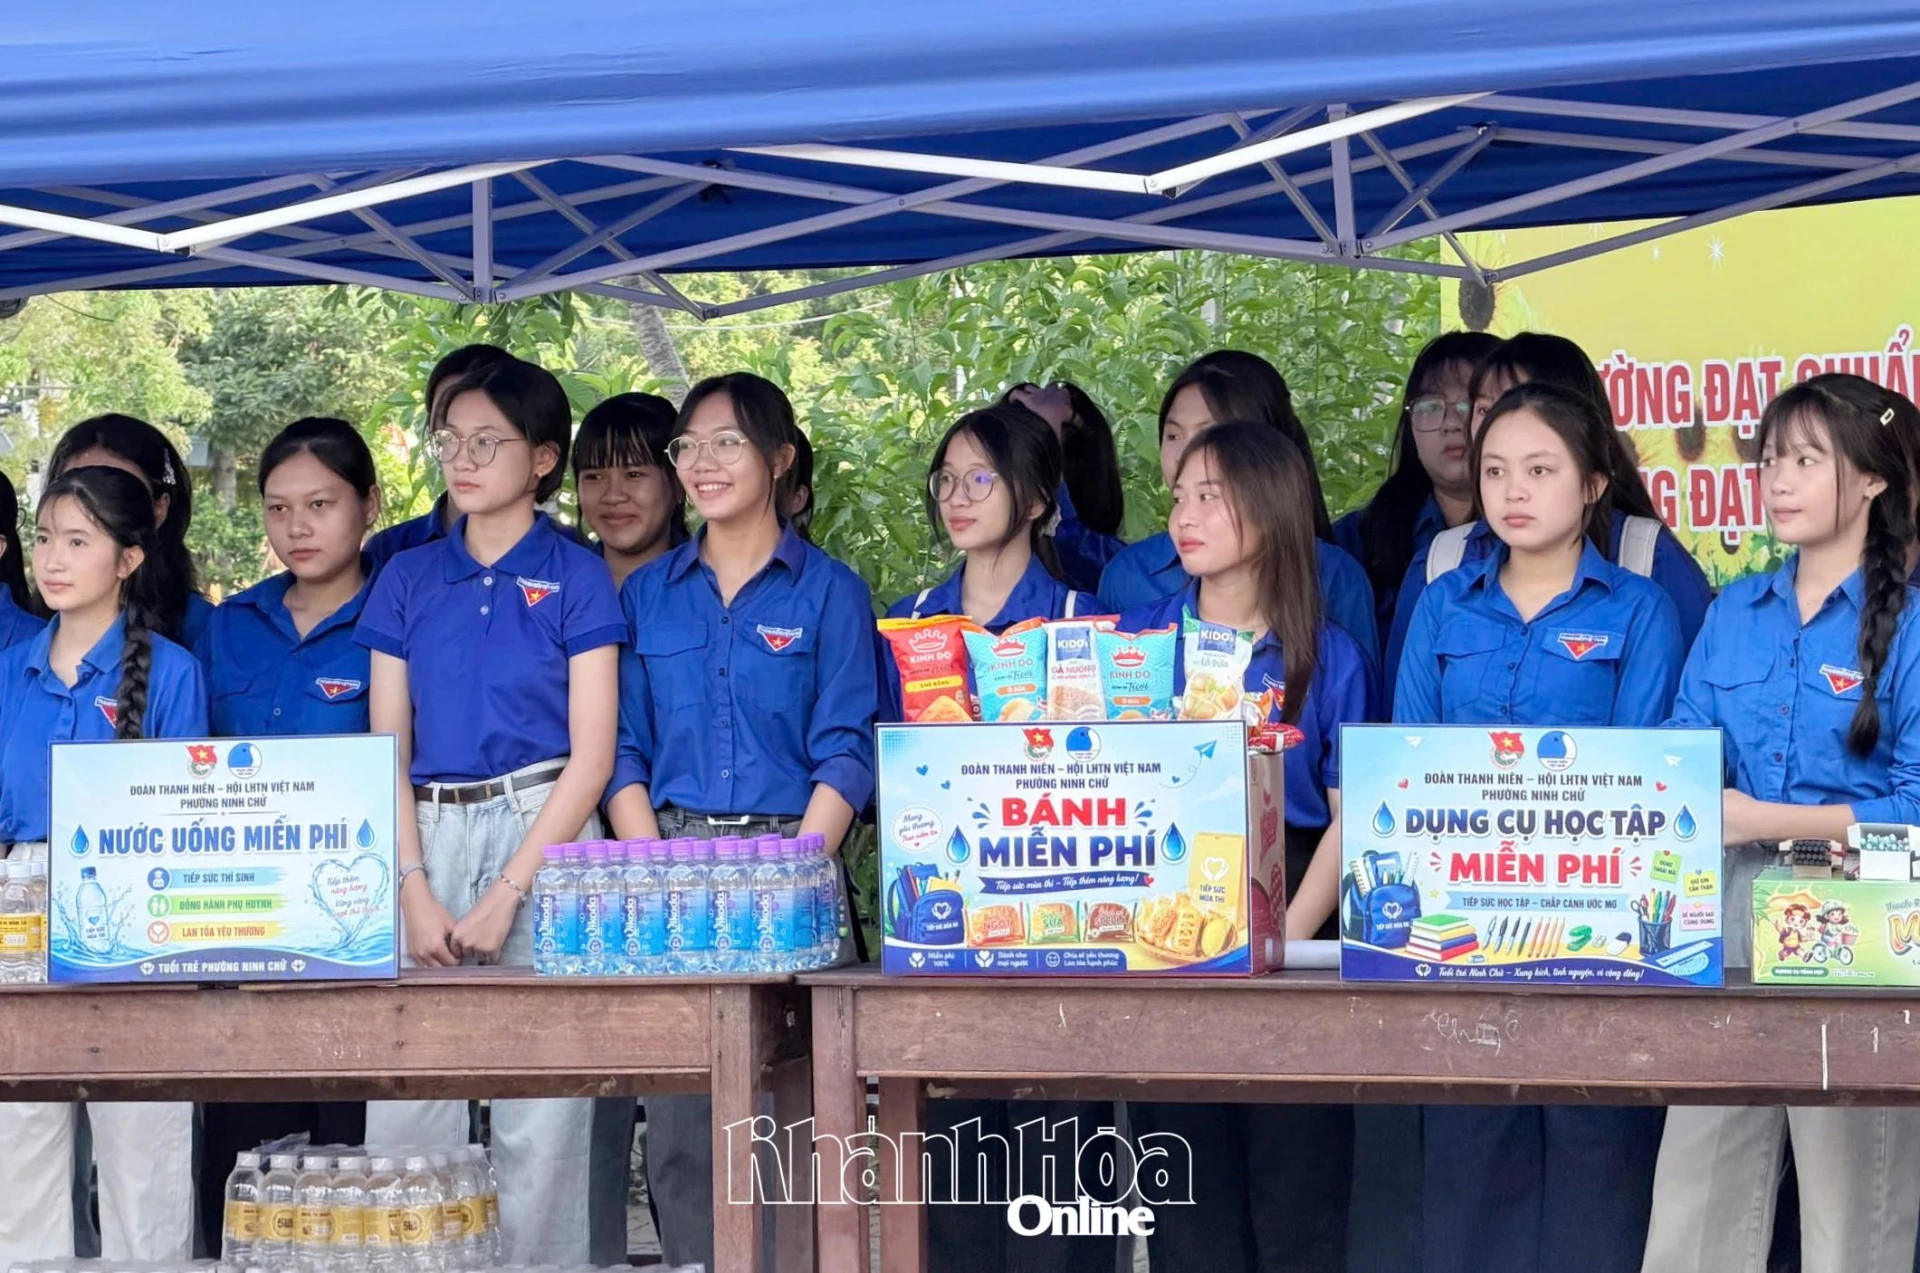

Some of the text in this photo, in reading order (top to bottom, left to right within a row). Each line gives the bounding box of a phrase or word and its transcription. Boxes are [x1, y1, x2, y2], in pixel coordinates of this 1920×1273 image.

[1704, 361, 1782, 434] ĐẠT
[1691, 468, 1767, 540] ĐẠT
[910, 651, 935, 664] KINH
[990, 660, 1017, 671] KINH
[1110, 671, 1133, 679] KINH
[961, 761, 1161, 776] ĐOÀN THANH NIÊN HỘI LHTN VIỆT NAM
[1016, 777, 1057, 789] PHƯỜNG
[1061, 778, 1085, 789] NINH
[1425, 770, 1642, 788] ĐOÀN THANH NIÊN HỘI LHTN VIỆT NAM
[130, 781, 315, 796] ĐOÀN THANH NIÊN HỘI LHTN VIỆT NAM
[1482, 788, 1527, 800] PHƯỜNG
[1531, 790, 1559, 801] NINH
[181, 796, 218, 809] PHƯỜNG
[222, 798, 244, 807] NINH
[1002, 792, 1126, 826] BÁNH
[1405, 803, 1666, 843] DỤNG CỤ HỌC TẬP
[99, 814, 348, 854] NƯỚC UỐNG MIỄN PHÍ
[979, 826, 1156, 867] MIỄN PHÍ
[1449, 840, 1623, 884] MIỄN PHÍ
[184, 872, 200, 883] TIẾP
[203, 872, 218, 883] SỨC
[235, 872, 255, 882] SINH
[203, 898, 225, 909] HÀNH
[227, 900, 243, 911] PHỤ
[245, 899, 272, 909] HUYNH
[1462, 896, 1478, 907] TIẾP
[1481, 896, 1495, 907] SỨC
[1498, 898, 1513, 908] HỌC
[1563, 897, 1584, 908] CÁNH
[1605, 899, 1617, 909] MƠ
[182, 927, 197, 937] LAN
[217, 924, 232, 936] YÊU
[234, 927, 265, 936] THƯƠNG
[159, 959, 179, 973] TUỔI
[182, 960, 198, 973] TRẺ
[202, 960, 239, 972] PHƯỜNG
[242, 961, 264, 972] NINH
